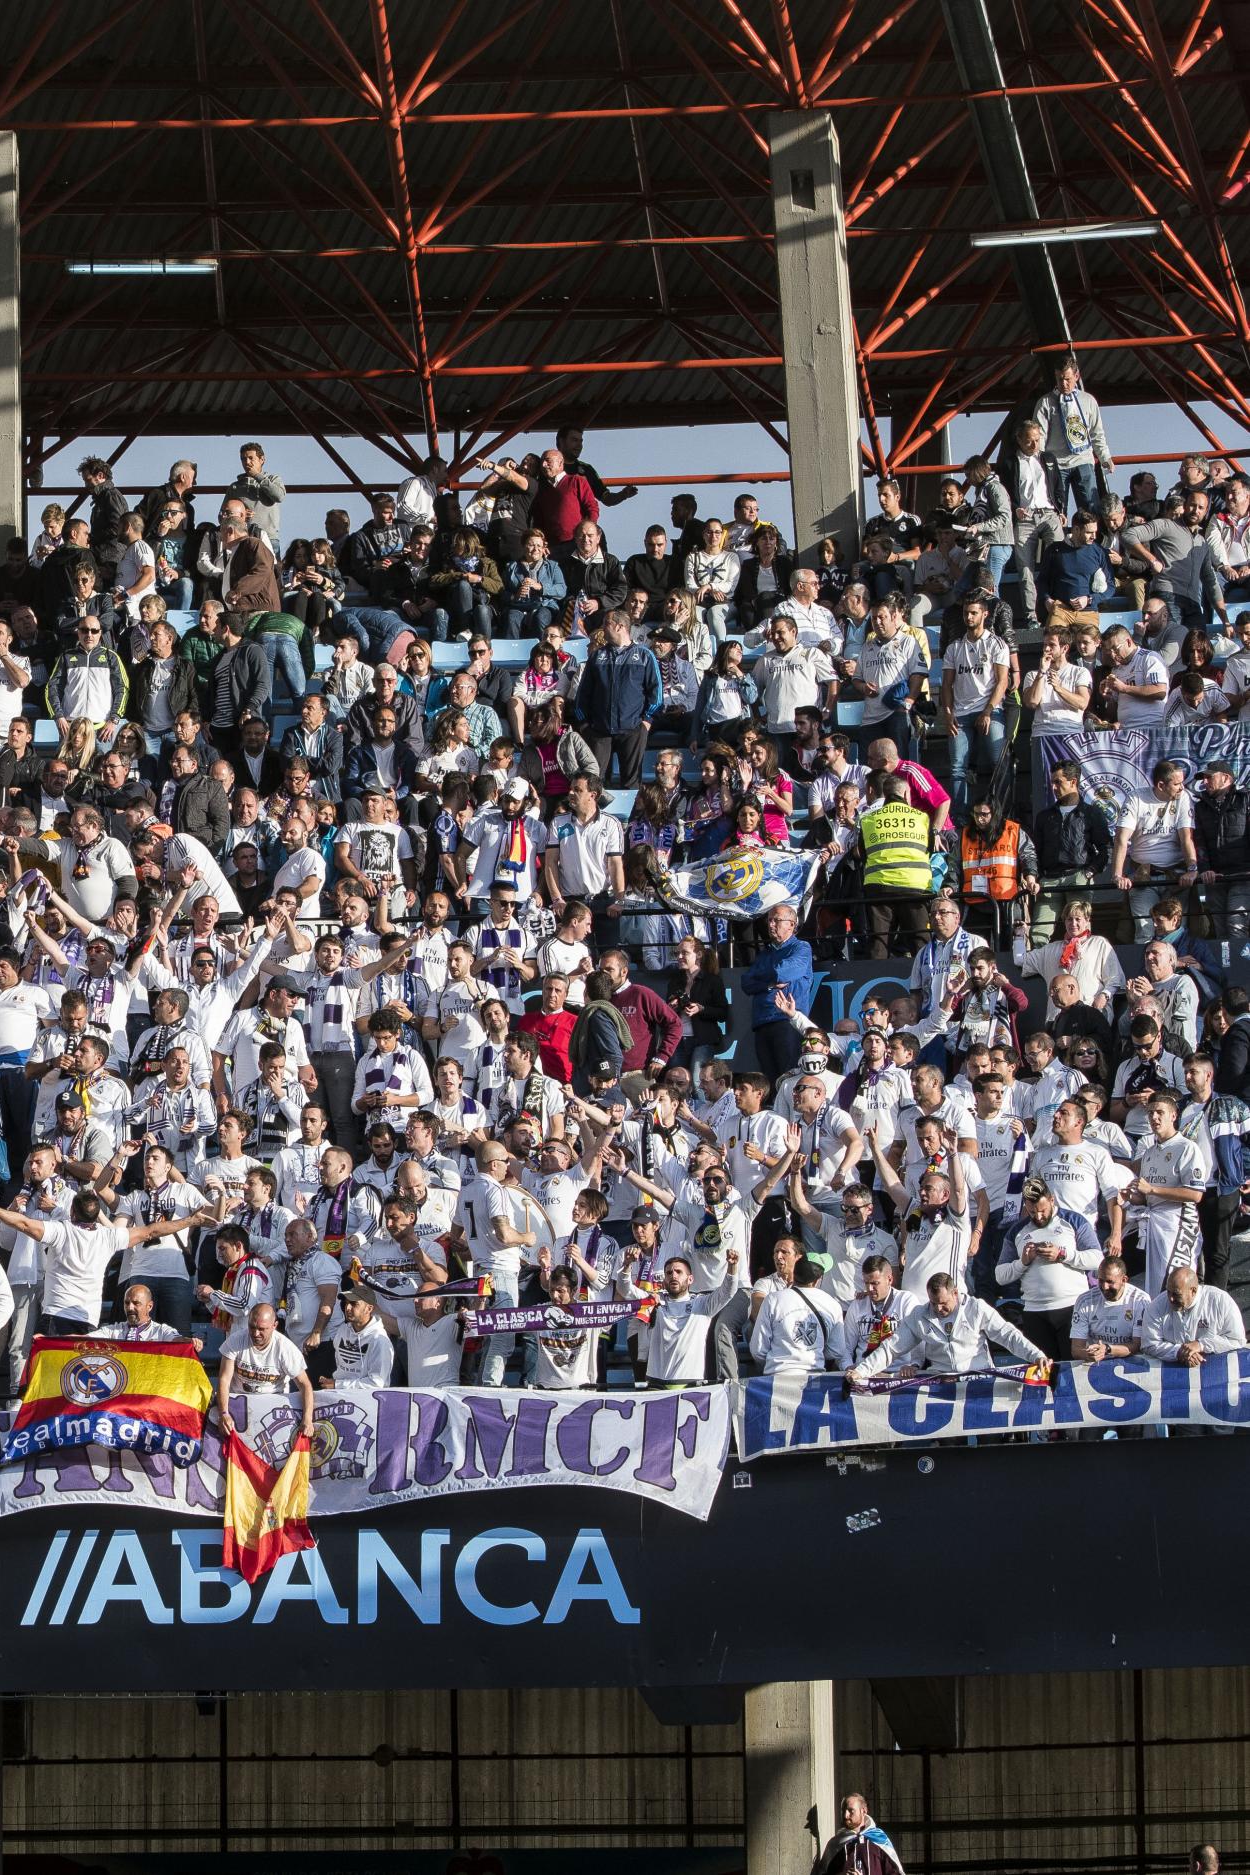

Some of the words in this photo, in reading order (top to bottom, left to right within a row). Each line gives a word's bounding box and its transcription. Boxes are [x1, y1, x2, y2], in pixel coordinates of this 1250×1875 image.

[958, 664, 984, 675] bwin
[875, 817, 916, 830] 36315
[879, 831, 926, 842] PROSEGUR
[425, 947, 437, 957] Fly
[455, 998, 467, 1006] Fly
[63, 1093, 69, 1101] S
[981, 1142, 993, 1150] Fly
[977, 1149, 1007, 1159] mirates
[1057, 1165, 1070, 1173] Fly
[1149, 1166, 1157, 1174] Fly
[1044, 1172, 1084, 1182] Emirates
[582, 1305, 594, 1315] TU
[478, 1312, 492, 1326] LA
[494, 1310, 544, 1326] CLASICA
[1105, 1325, 1117, 1334] Fly
[745, 1371, 859, 1457] LA
[369, 1390, 711, 1494] RMCF
[77, 1527, 641, 1626] ABANCA
